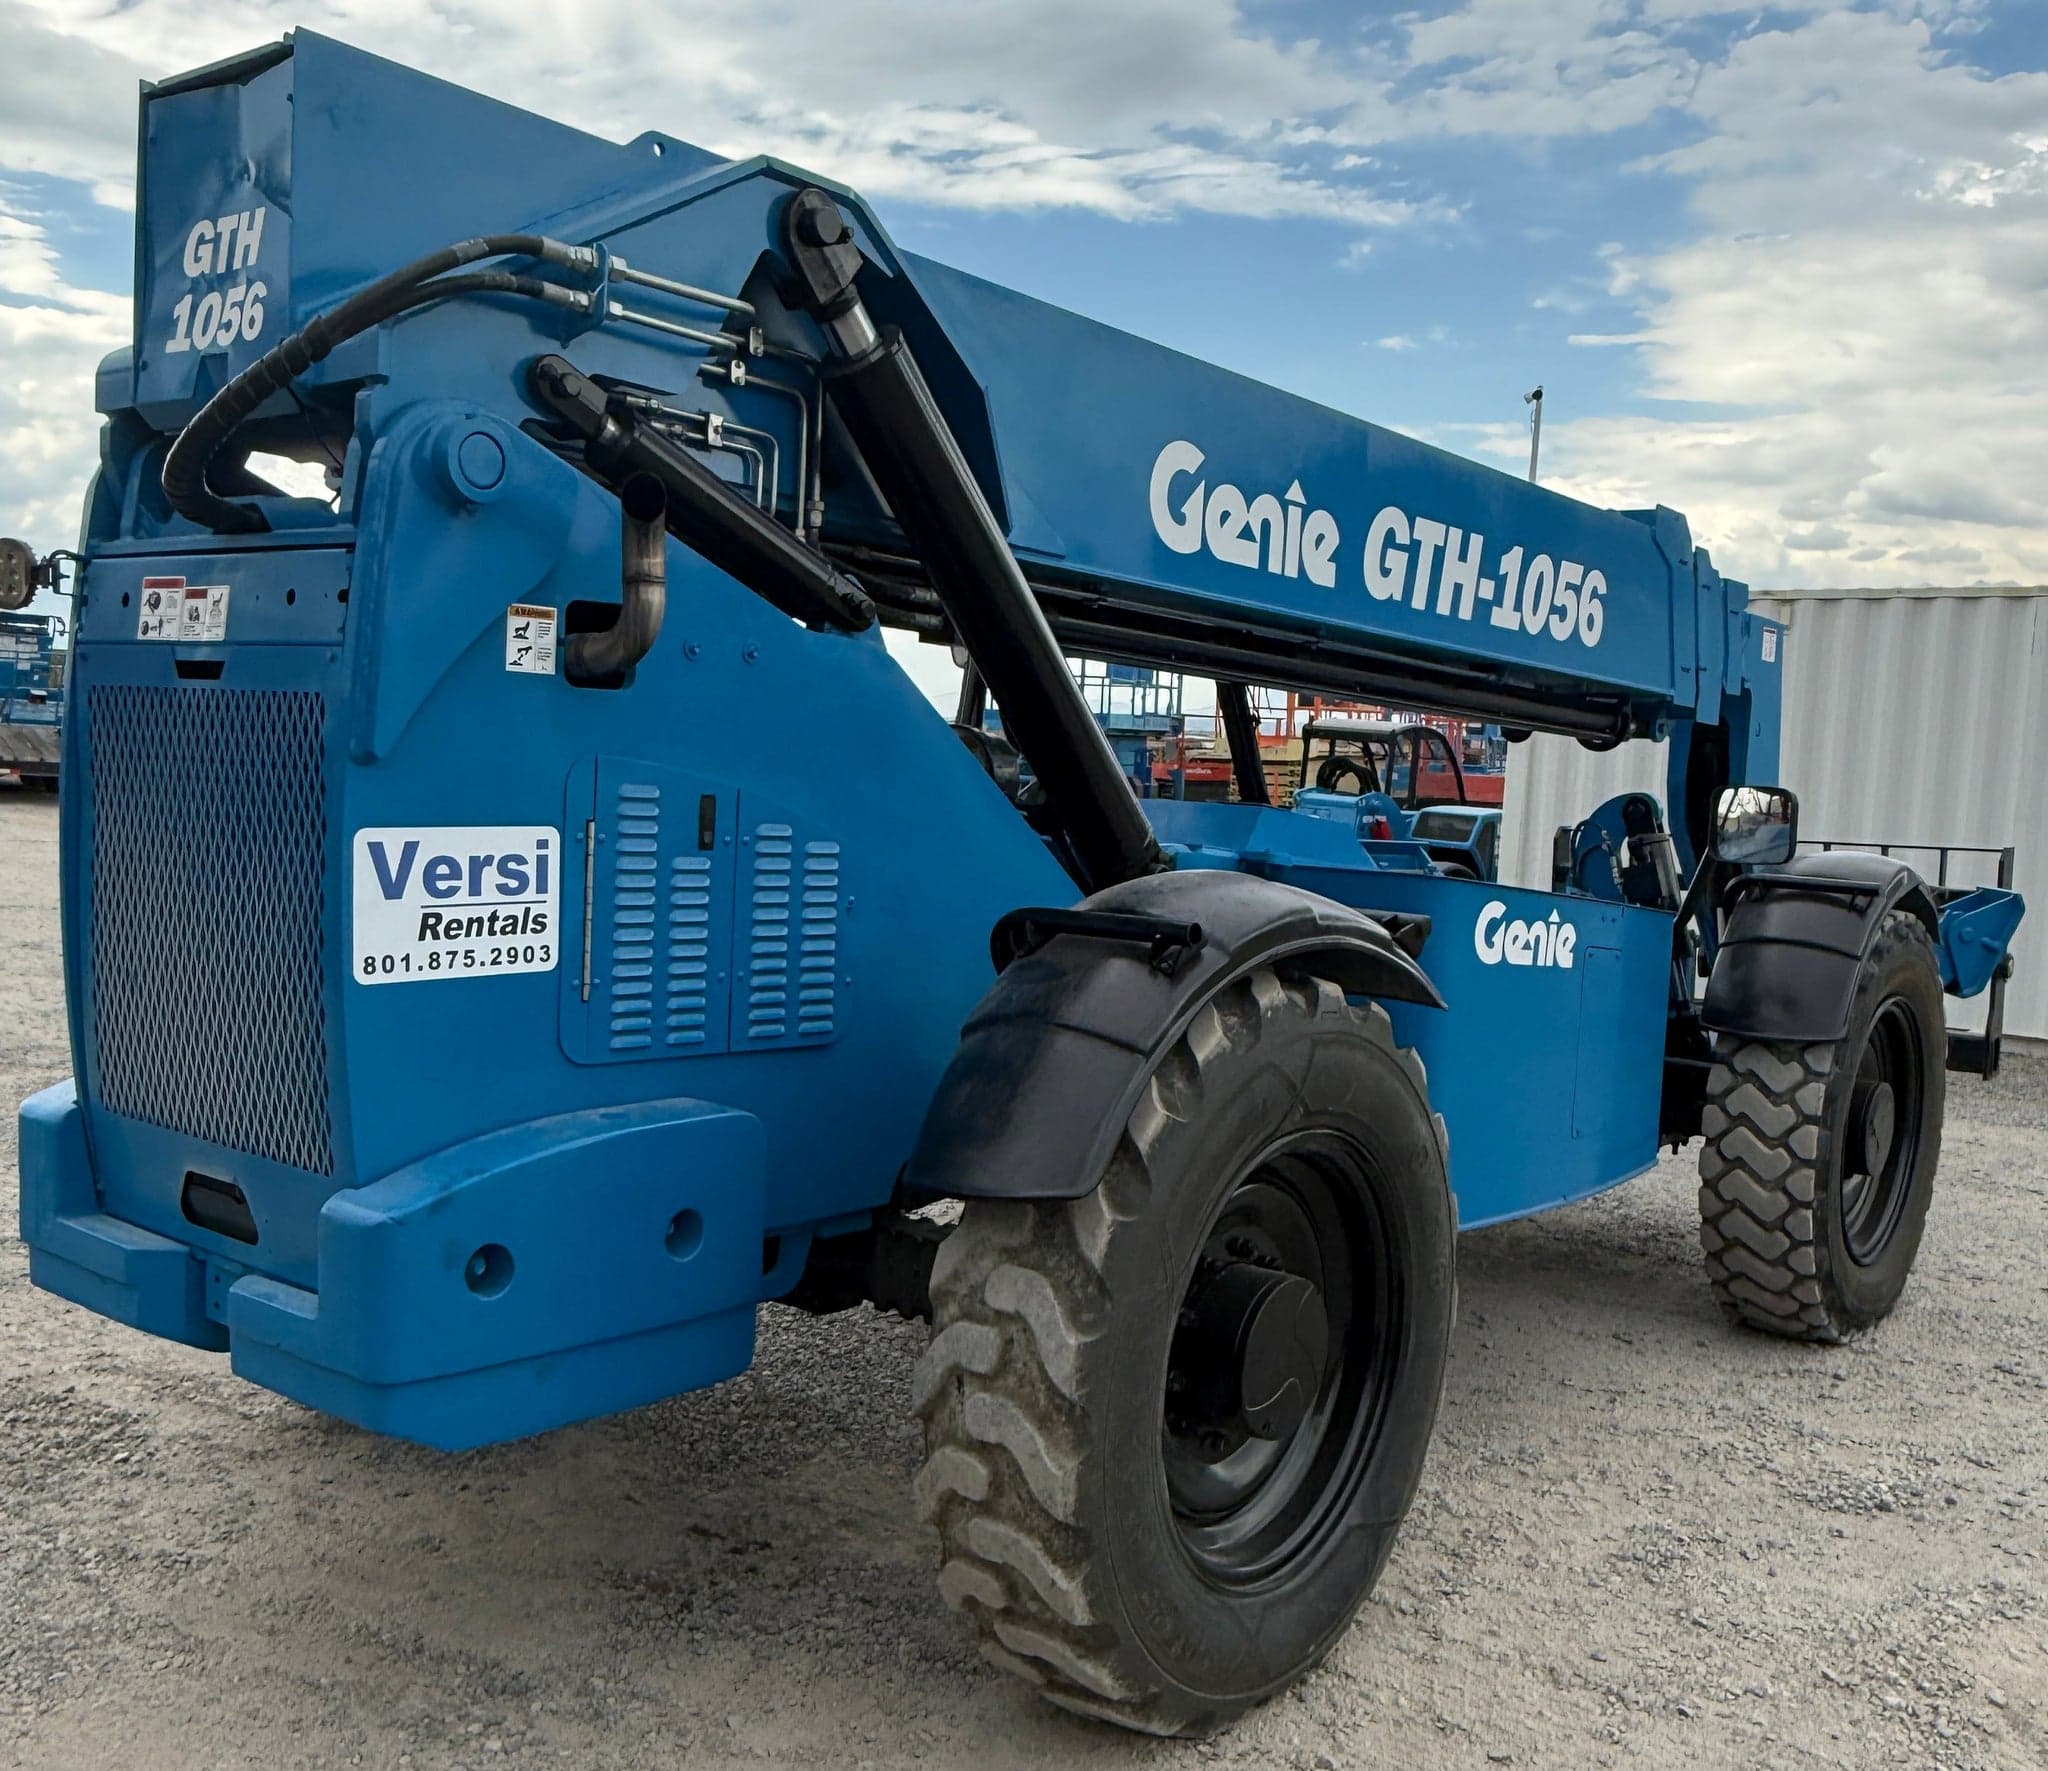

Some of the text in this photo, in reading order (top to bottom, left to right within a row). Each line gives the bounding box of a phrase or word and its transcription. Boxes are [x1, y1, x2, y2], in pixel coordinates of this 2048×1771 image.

[183, 206, 266, 278] GTH
[165, 281, 268, 353] 1056
[1149, 440, 1608, 648] Genie GTH-1056
[367, 839, 549, 901] Versi
[418, 906, 548, 942] Rentals
[1474, 900, 1577, 969] Genie
[363, 944, 551, 975] 801.875.2903
